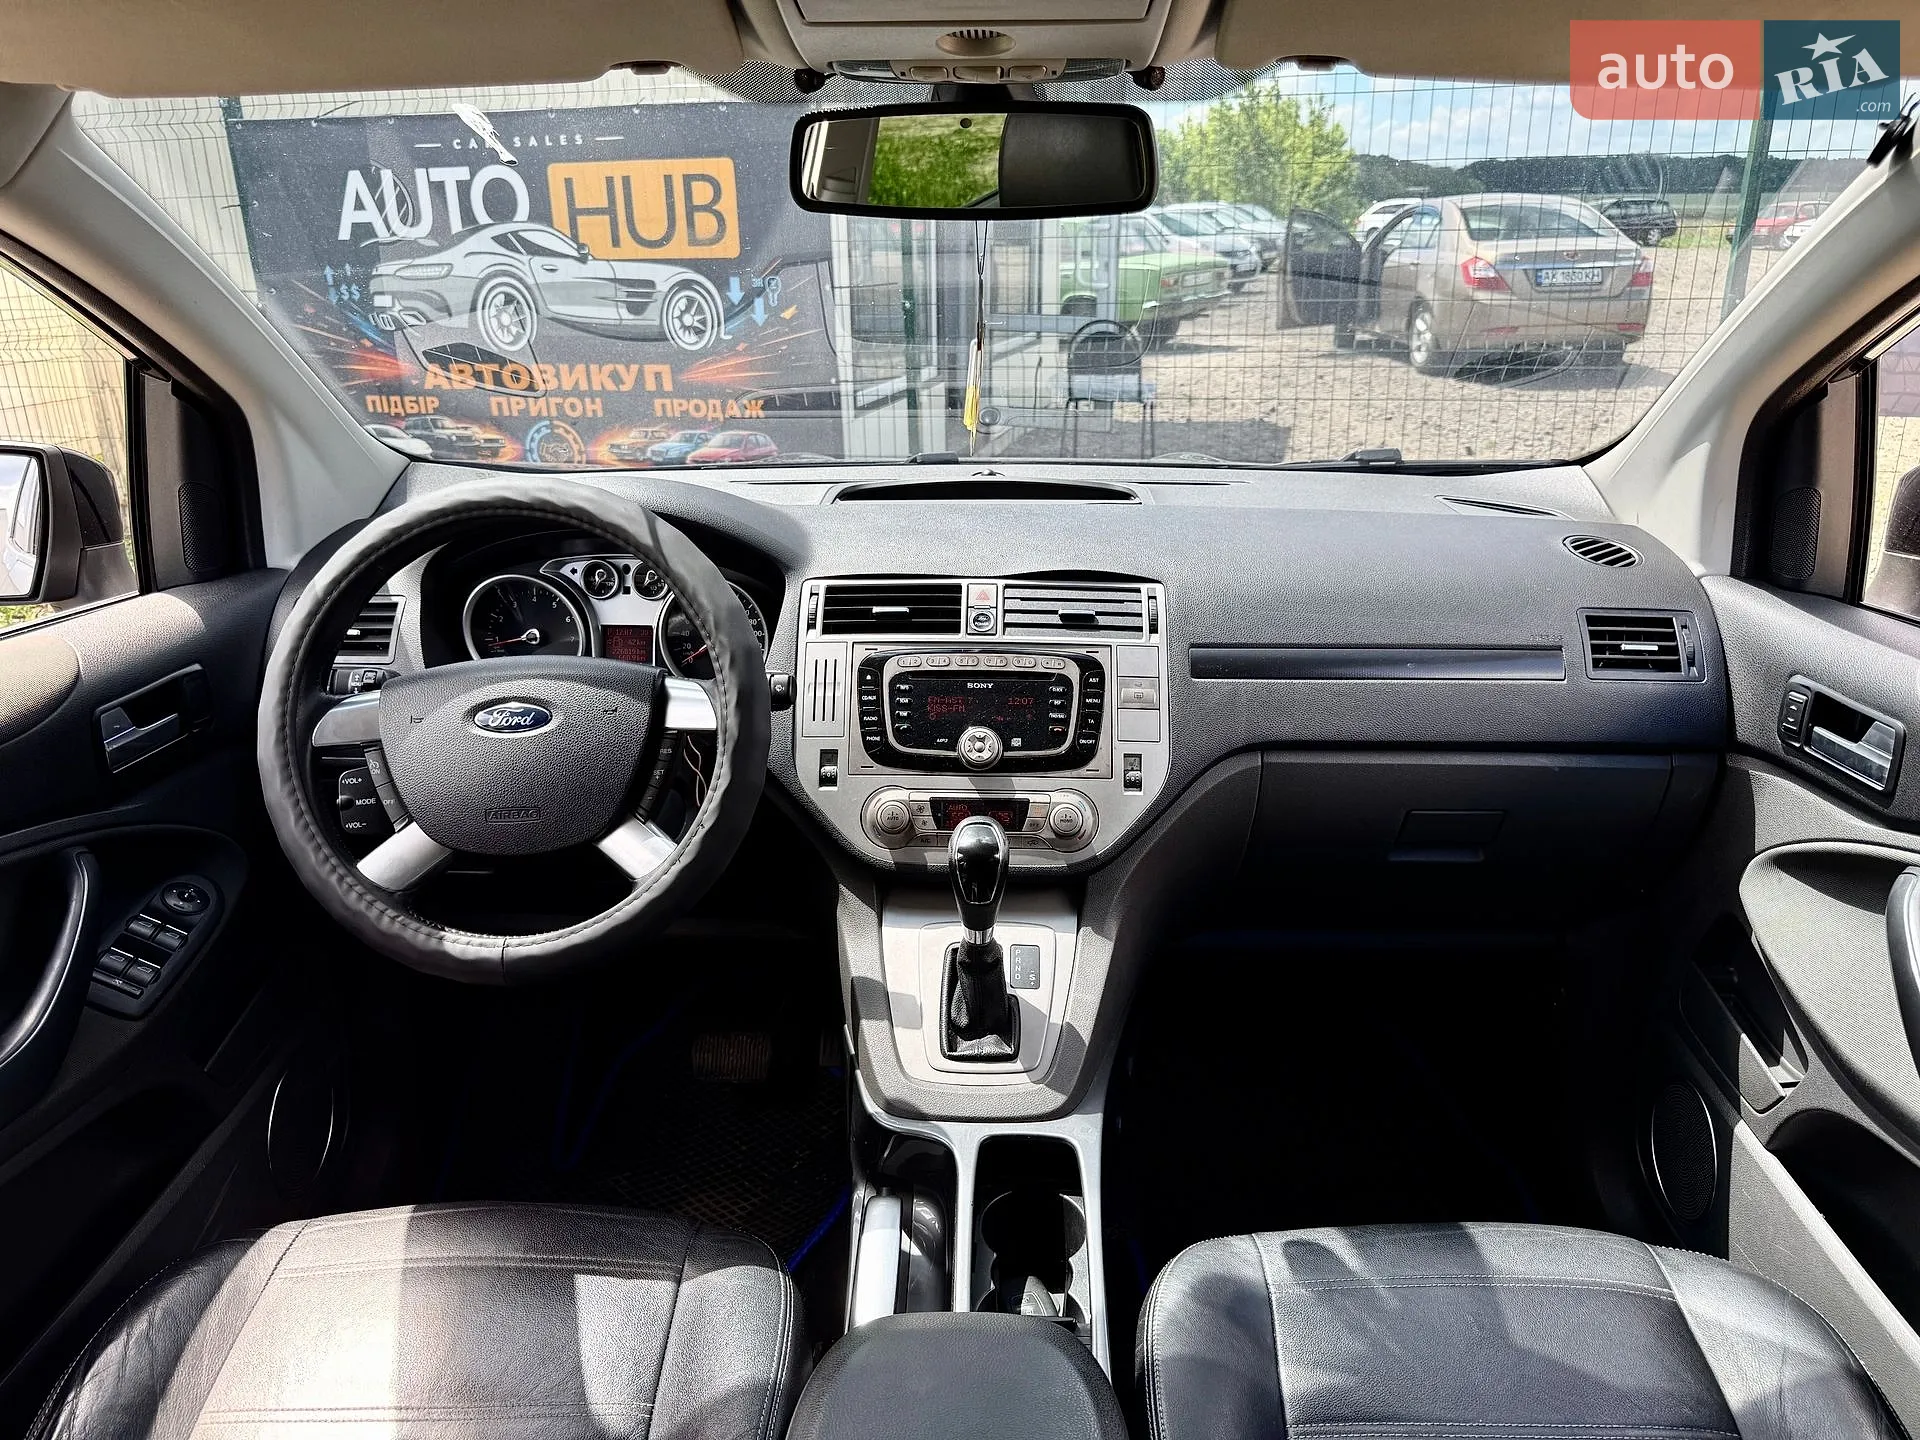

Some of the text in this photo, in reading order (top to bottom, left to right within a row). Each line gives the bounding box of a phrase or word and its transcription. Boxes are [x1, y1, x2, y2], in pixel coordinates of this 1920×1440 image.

[513, 133, 583, 147] SALES
[337, 164, 727, 250] AUTO HUB
[423, 364, 673, 392] АВТОВИКУП
[365, 395, 766, 421] ПІДБІР ПРИГОН ПРОДАЖ
[927, 704, 965, 713] KISS-FM
[488, 708, 536, 727] Ford
[355, 798, 377, 806] MODE
[489, 810, 538, 820] AIRBAG
